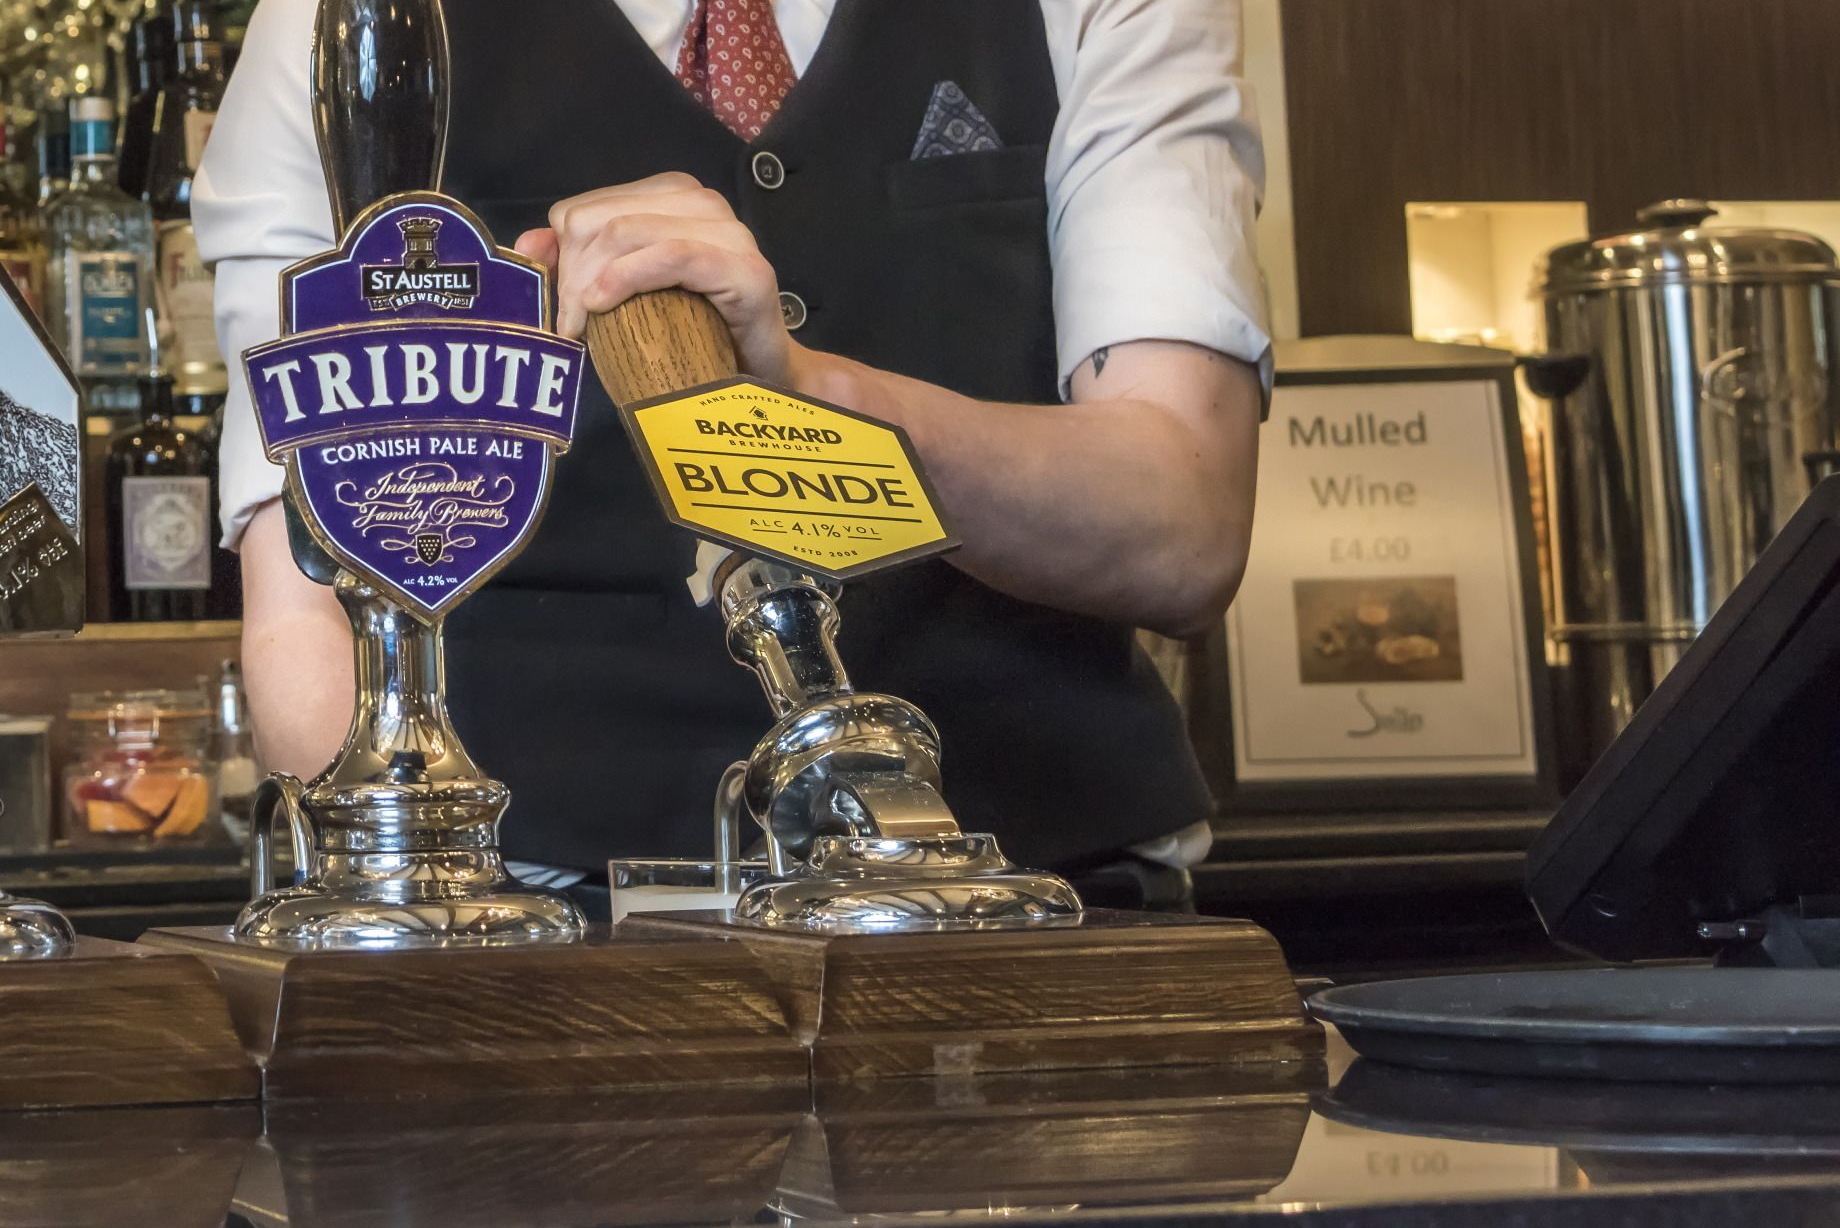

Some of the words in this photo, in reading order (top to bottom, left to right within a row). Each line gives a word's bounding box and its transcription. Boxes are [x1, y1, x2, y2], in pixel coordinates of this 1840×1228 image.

[396, 292, 448, 307] BREWERY
[262, 343, 570, 423] TRIBUTE
[699, 394, 726, 407] HAND
[731, 393, 781, 404] CRAFTED
[787, 402, 815, 415] ALES
[694, 419, 843, 445] BACKYARD
[1288, 409, 1428, 447] Mulled
[323, 438, 420, 465] CORNISH
[430, 437, 478, 455] PALE
[486, 441, 523, 460] ALE
[729, 439, 822, 452] BREWHOUSE
[364, 470, 486, 503] Independent
[673, 462, 915, 508] BLONDE
[1310, 474, 1417, 508] Wine
[17, 514, 47, 541] beer
[352, 500, 430, 534] Family
[429, 500, 507, 525] Brewers
[750, 518, 786, 529] ALC
[791, 522, 842, 539] 4.1%
[842, 525, 880, 535] VOL
[793, 545, 822, 556] ESTD
[1329, 535, 1411, 563] £4.00
[417, 575, 445, 586] 4.2%
